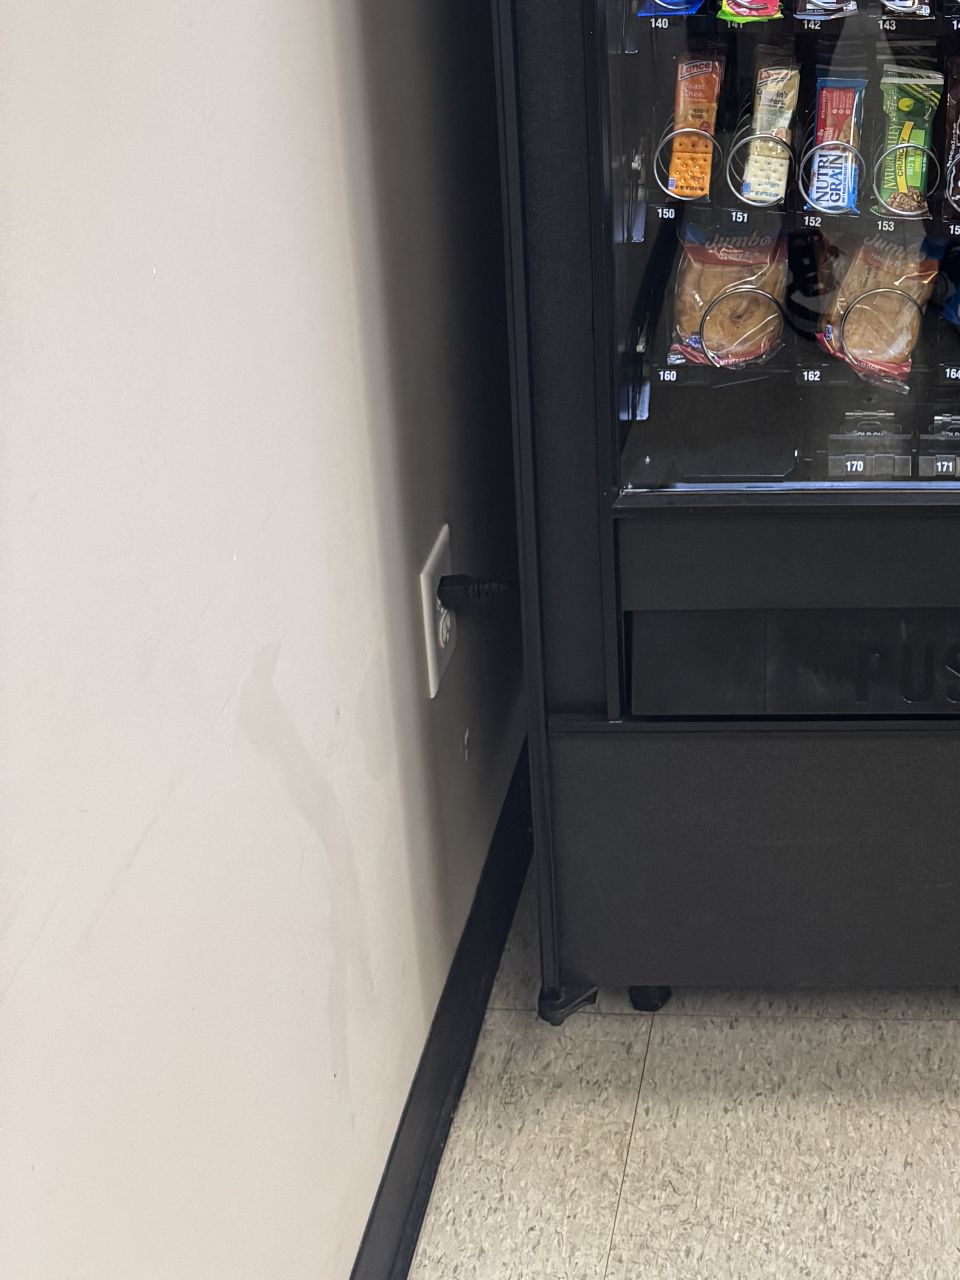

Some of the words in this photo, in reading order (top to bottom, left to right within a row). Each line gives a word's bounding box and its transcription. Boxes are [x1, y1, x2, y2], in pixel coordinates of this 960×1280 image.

[650, 18, 669, 29] 140
[803, 20, 821, 30] 142
[878, 20, 896, 30] 143
[680, 62, 710, 75] Lance
[883, 156, 897, 189] NATURE
[816, 154, 829, 203] NUTRI
[829, 154, 843, 203] GRAIN
[657, 209, 675, 219] 150
[731, 212, 748, 222] 151
[804, 216, 821, 227] 152
[877, 221, 895, 231] 153
[705, 230, 772, 248] Jumbo
[658, 371, 677, 381] 160
[802, 371, 821, 381] 162
[846, 461, 863, 472] 170
[937, 462, 953, 472] 171
